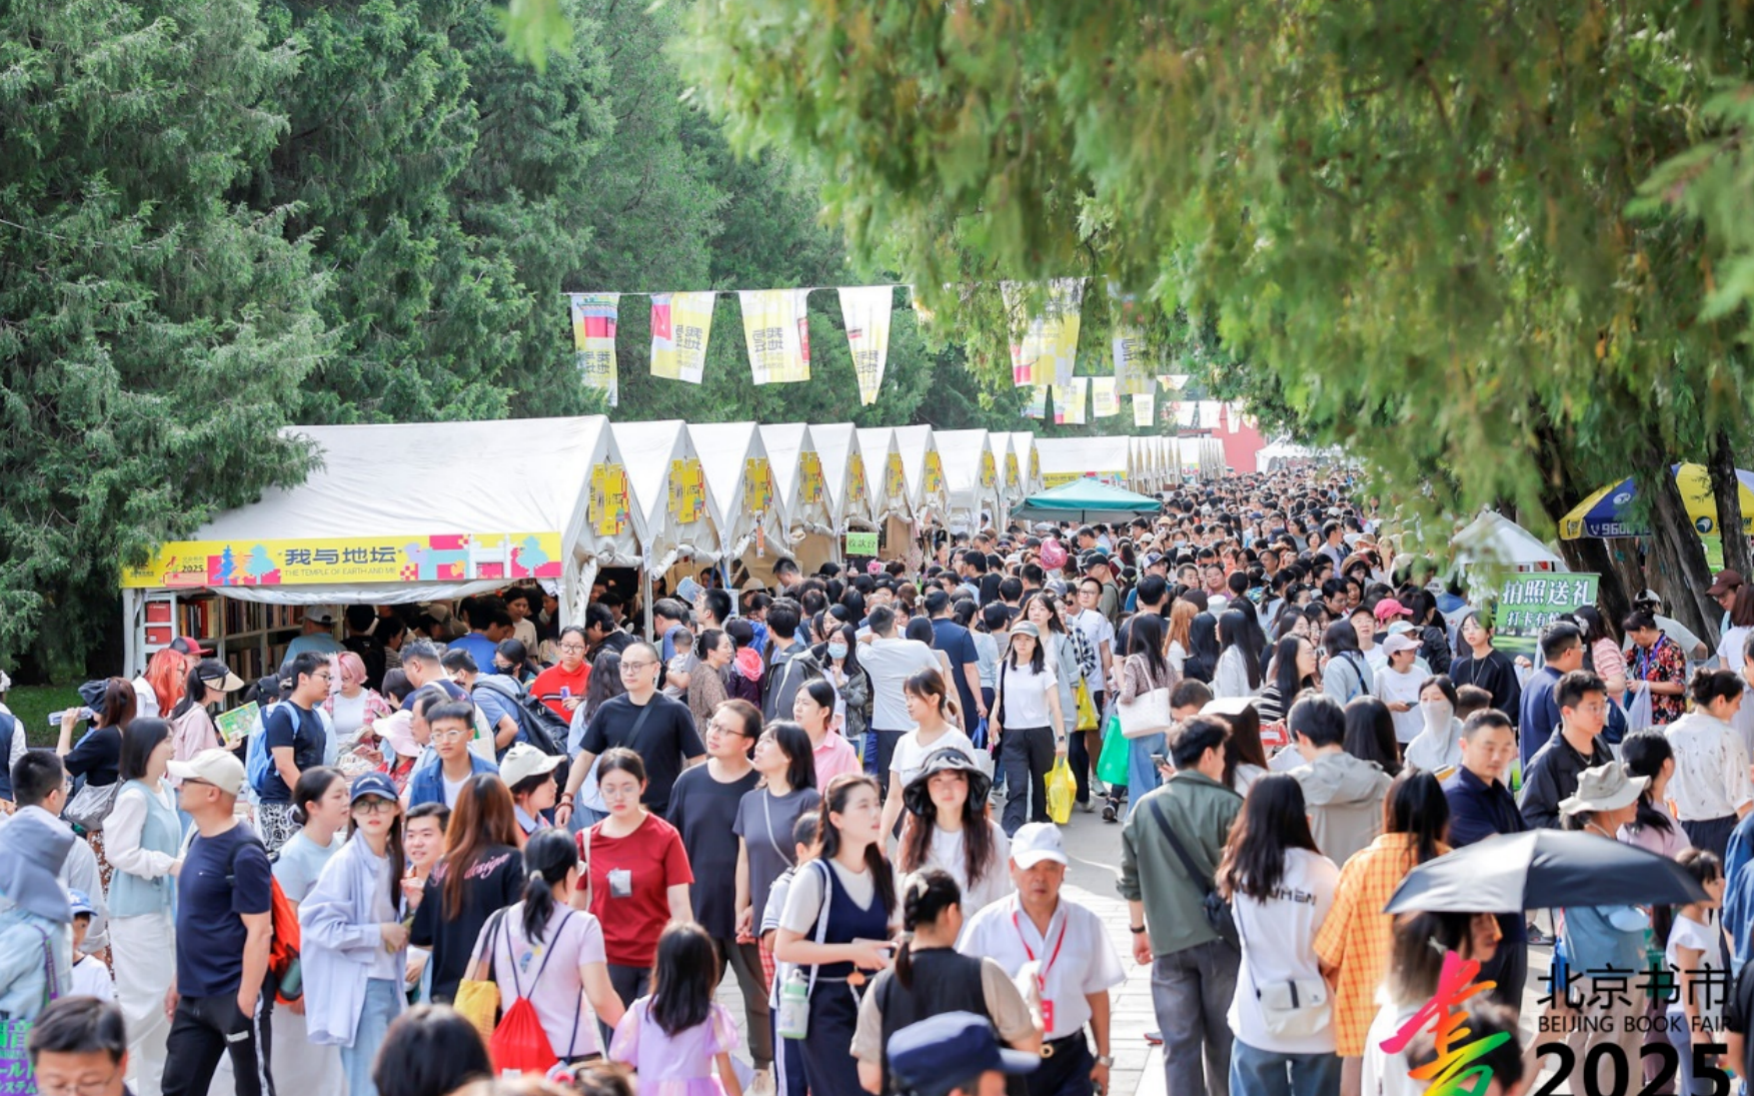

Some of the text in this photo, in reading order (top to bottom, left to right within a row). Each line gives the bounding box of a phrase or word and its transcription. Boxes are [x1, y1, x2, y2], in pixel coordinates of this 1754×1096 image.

[285, 546, 396, 565] 我与地坛
[182, 564, 204, 573] 2025
[285, 568, 299, 577] THE
[301, 567, 328, 577] TEMPLE
[331, 567, 341, 576] OF
[342, 566, 367, 576] EARTH
[368, 566, 384, 575] AND
[1502, 579, 1594, 606] 拍照送礼
